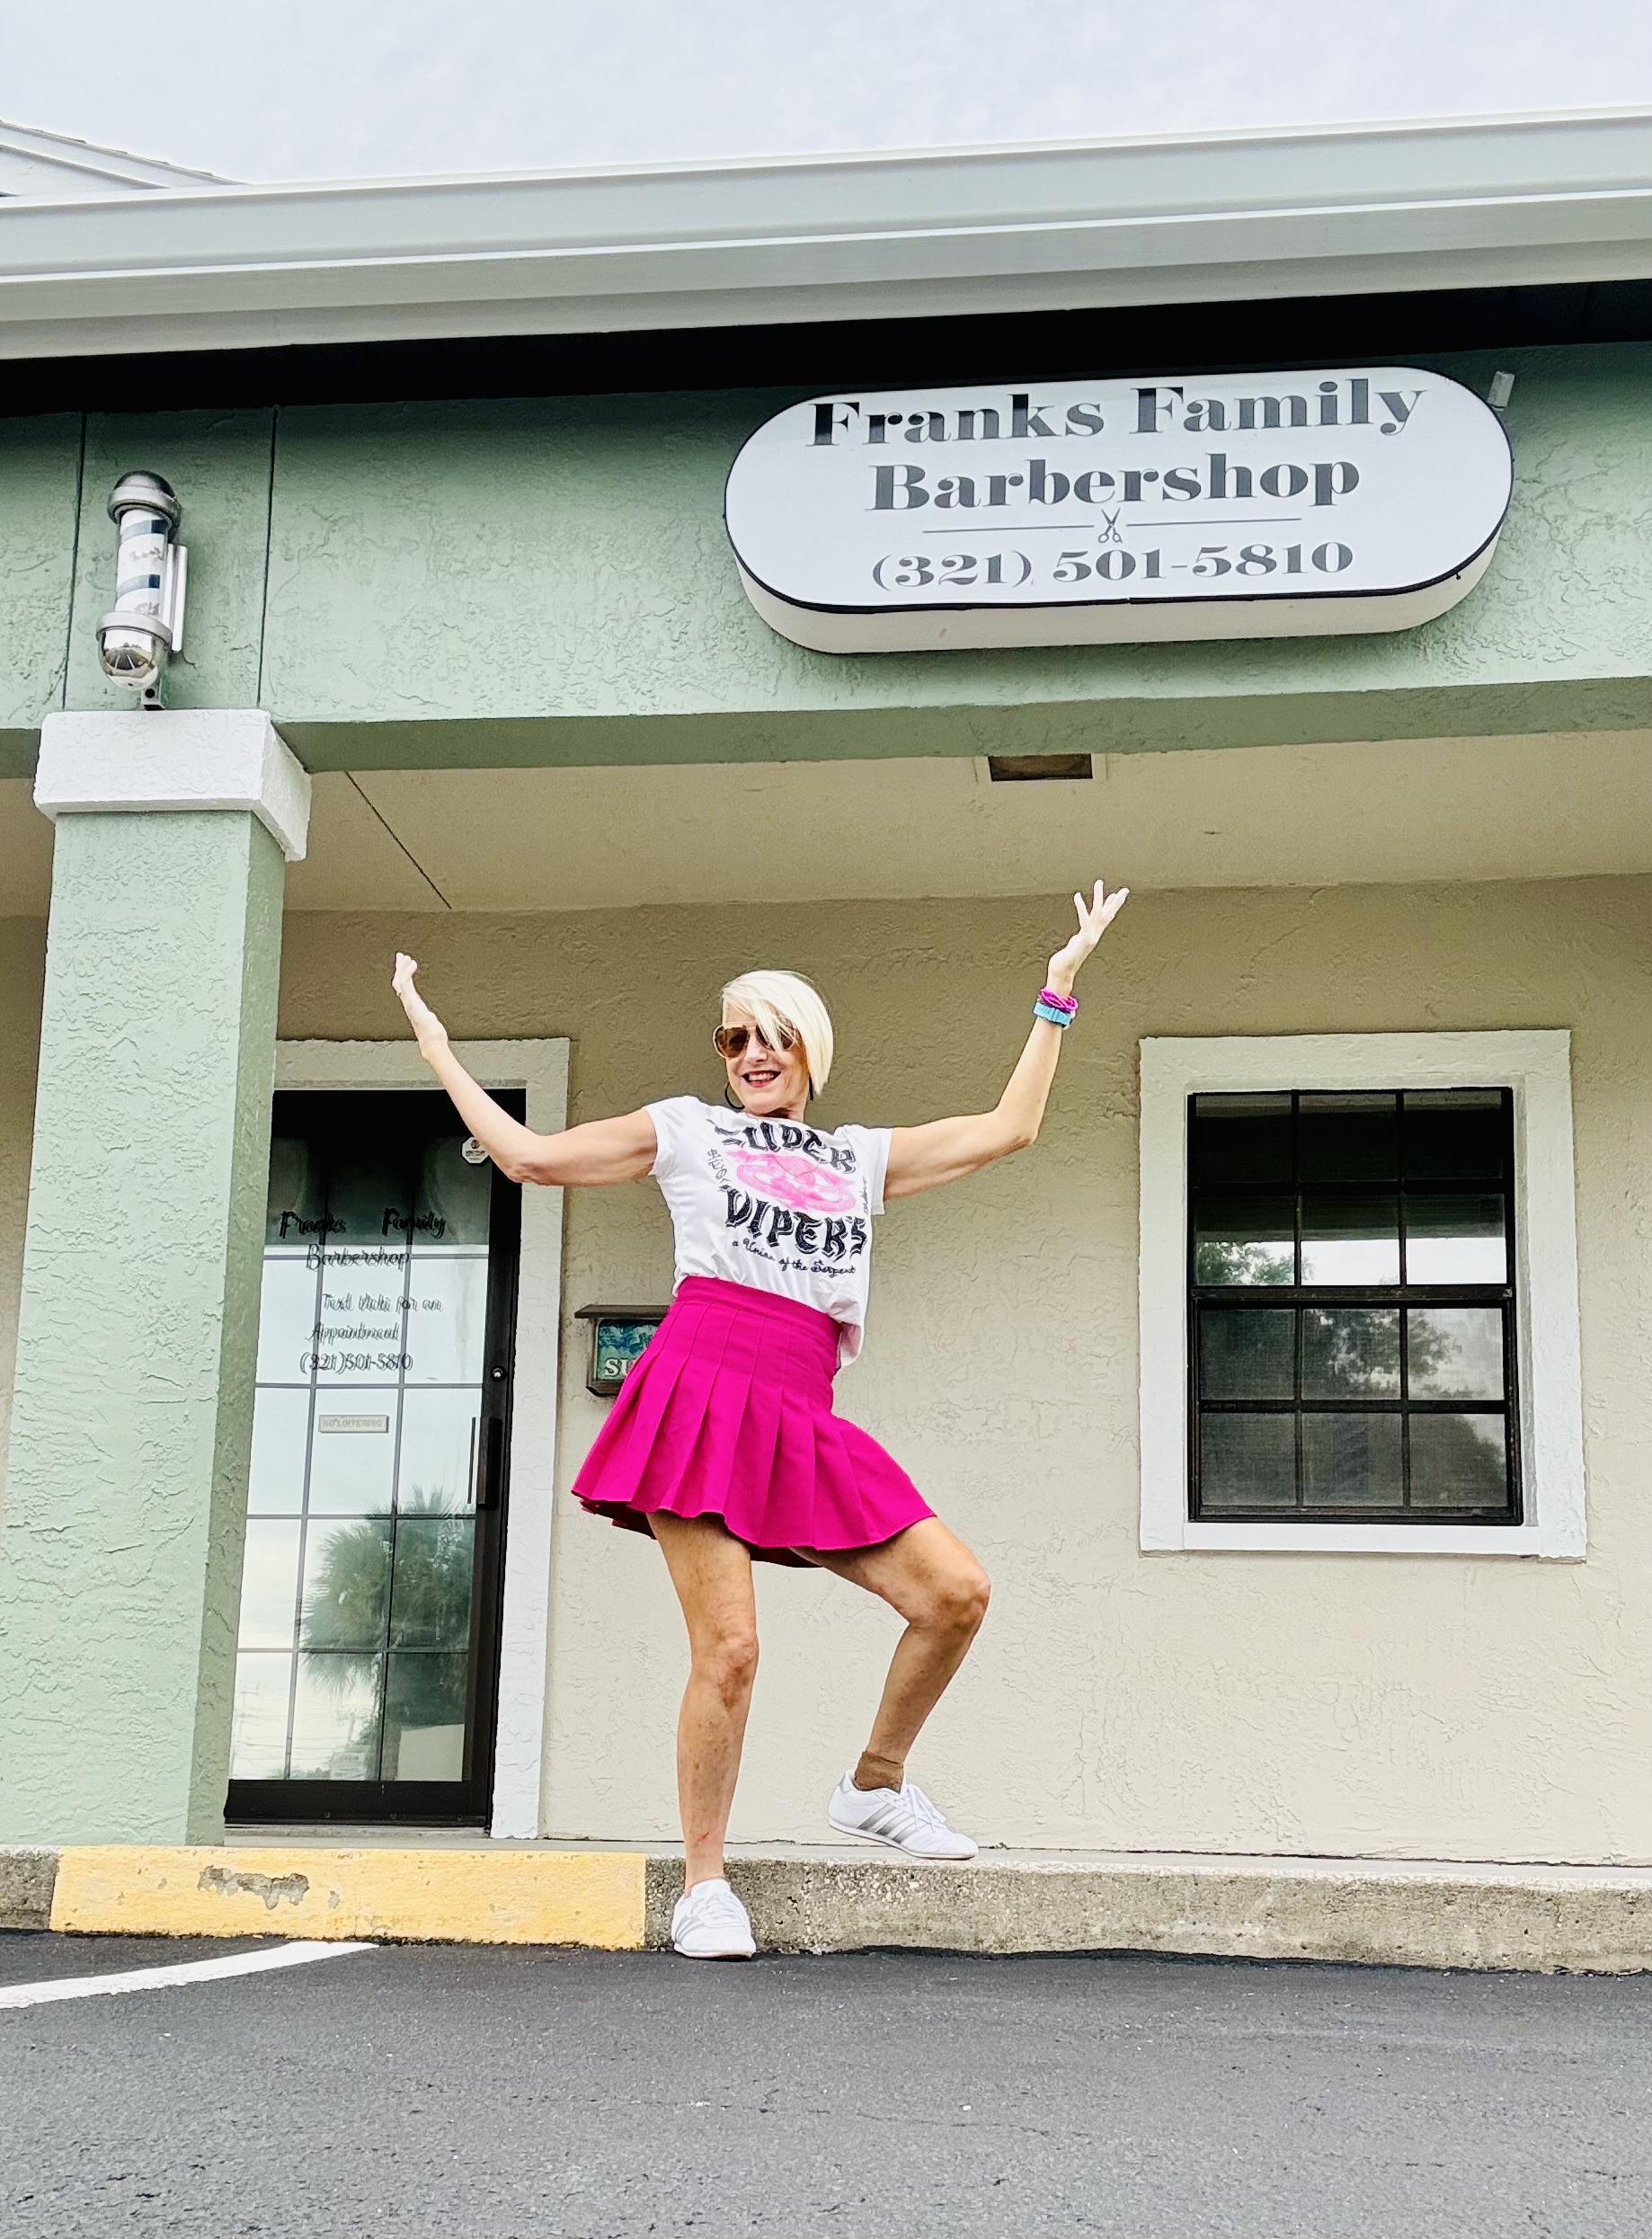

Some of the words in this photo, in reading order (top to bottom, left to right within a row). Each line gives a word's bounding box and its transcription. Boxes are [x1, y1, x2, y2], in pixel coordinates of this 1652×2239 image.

[805, 393, 1105, 447] Franks
[1129, 378, 1427, 435] Family
[865, 453, 1359, 511] Barbershop
[873, 550, 1033, 591] (321)
[1052, 541, 1354, 582] 501-5810
[280, 1210, 346, 1239] Franks
[381, 1207, 446, 1239] Family
[718, 1185, 868, 1263] VIPERS
[306, 1243, 410, 1272] Barbershop
[322, 1293, 352, 1311] Text
[395, 1295, 418, 1314] for
[422, 1299, 443, 1311] an
[305, 1321, 400, 1346] Appointment
